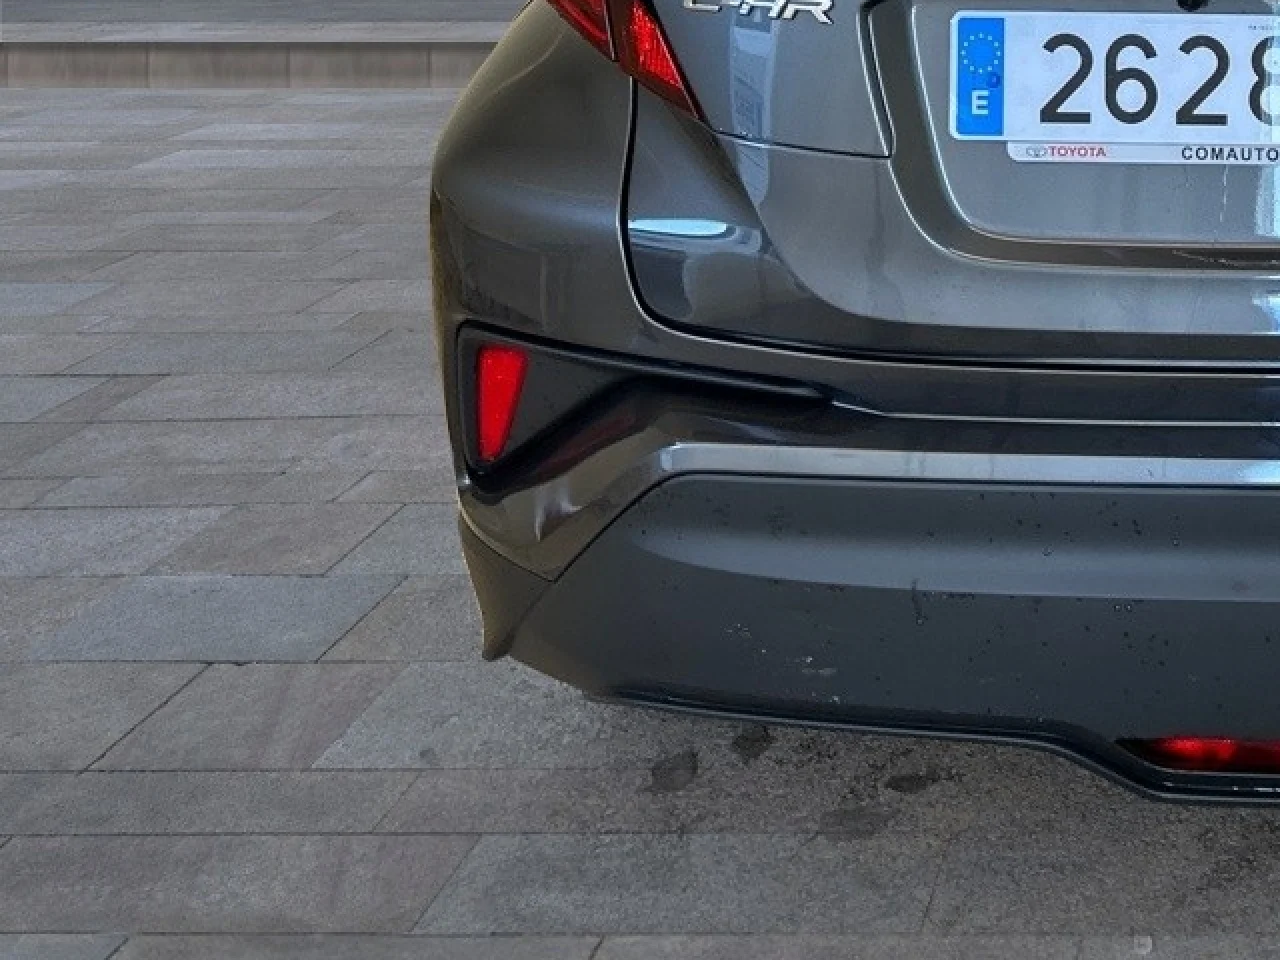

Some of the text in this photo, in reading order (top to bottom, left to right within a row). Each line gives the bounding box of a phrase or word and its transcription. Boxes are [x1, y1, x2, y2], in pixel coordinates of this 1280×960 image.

[971, 89, 989, 115] E
[1048, 145, 1107, 158] TOYOTA
[1181, 145, 1279, 162] COMAUTO
